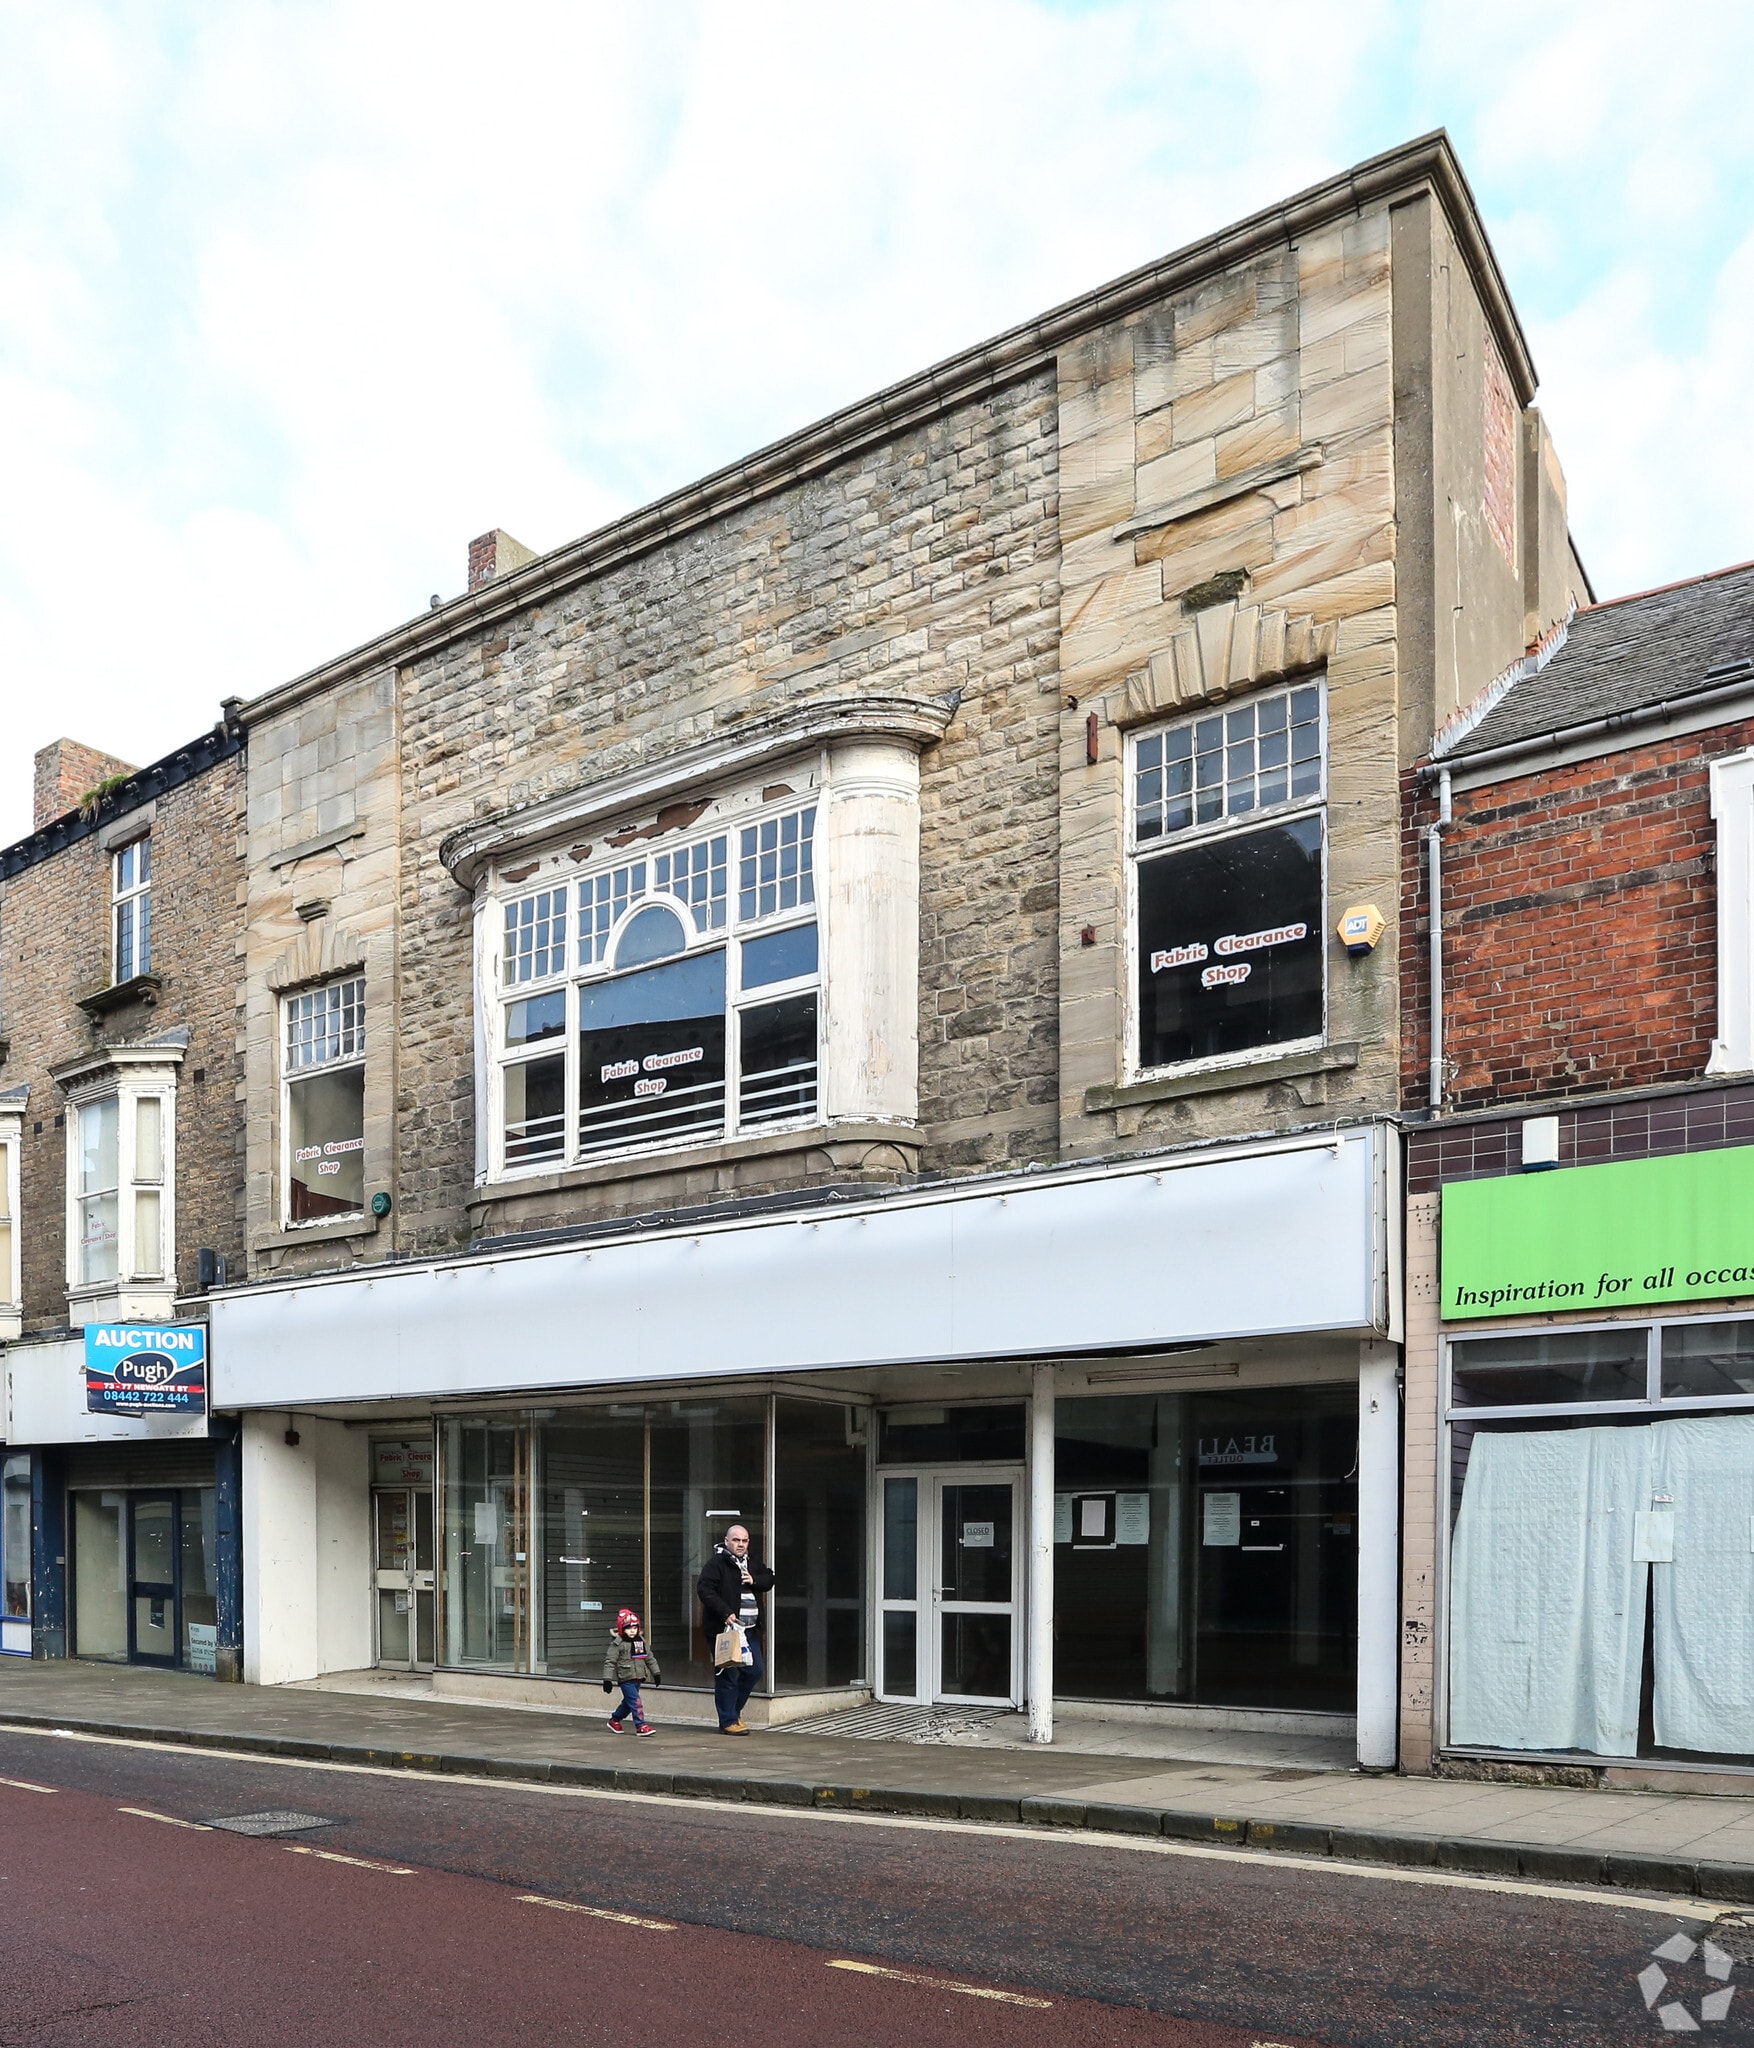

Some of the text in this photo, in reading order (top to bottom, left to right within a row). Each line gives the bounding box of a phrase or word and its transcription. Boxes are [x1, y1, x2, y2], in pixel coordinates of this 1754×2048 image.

[1347, 919, 1367, 931] ADT
[1153, 924, 1306, 970] Fabric Clearance
[1204, 965, 1250, 985] Shop
[602, 1049, 702, 1081] Fabric Clearance
[636, 1080, 666, 1095] Shop
[296, 1139, 364, 1161] Fabric Clearance
[319, 1162, 339, 1174] Shop
[1455, 1280, 1585, 1308] Inspiration
[1594, 1273, 1633, 1299] for
[1643, 1267, 1675, 1290] all
[94, 1328, 194, 1350] AUCTION
[122, 1360, 168, 1383] Pugh
[133, 1384, 175, 1392] NEWGATE
[103, 1391, 189, 1403] 08442 722 444
[380, 1453, 402, 1462] Fabric
[401, 1469, 421, 1479] Shop
[966, 1527, 990, 1535] CLOSED
